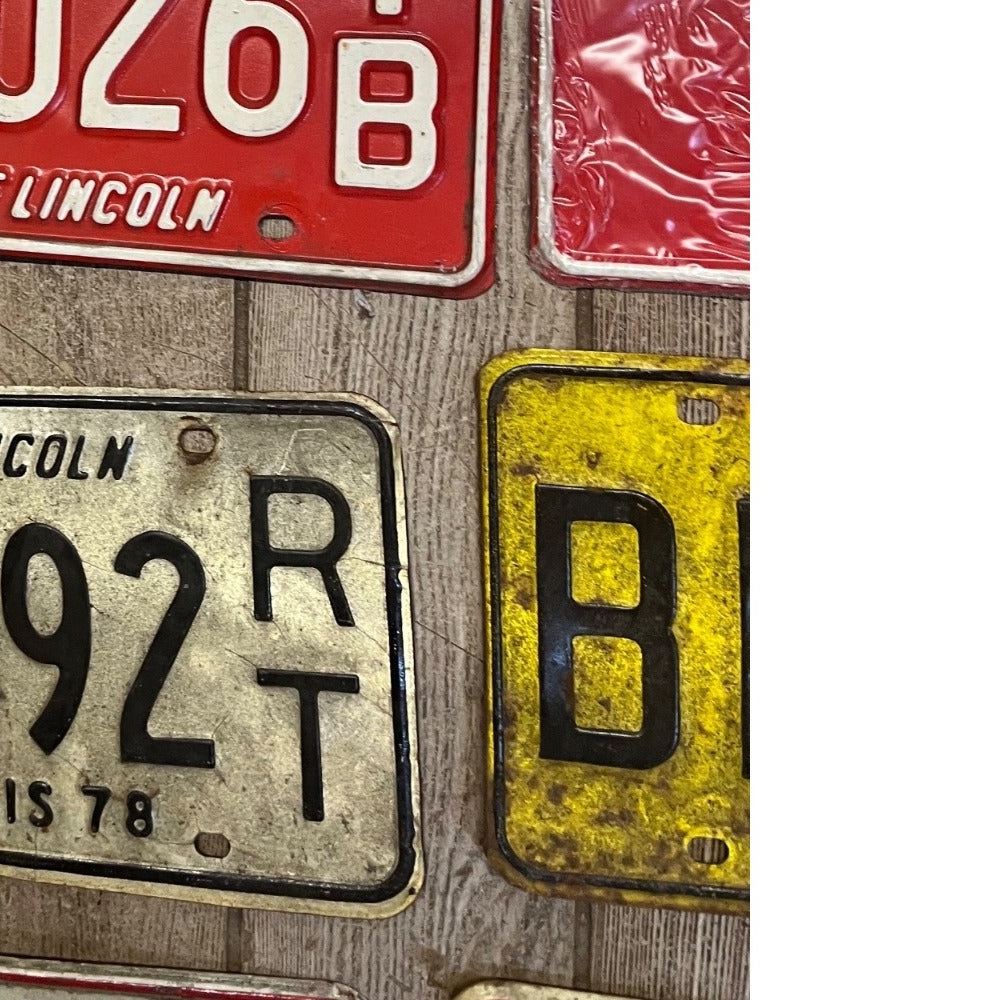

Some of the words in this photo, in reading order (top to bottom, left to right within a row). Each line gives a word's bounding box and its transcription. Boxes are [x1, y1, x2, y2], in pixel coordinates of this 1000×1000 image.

[10, 178, 231, 232] LINCOLN
[536, 482, 750, 779] B
[83, 785, 154, 839] 78
